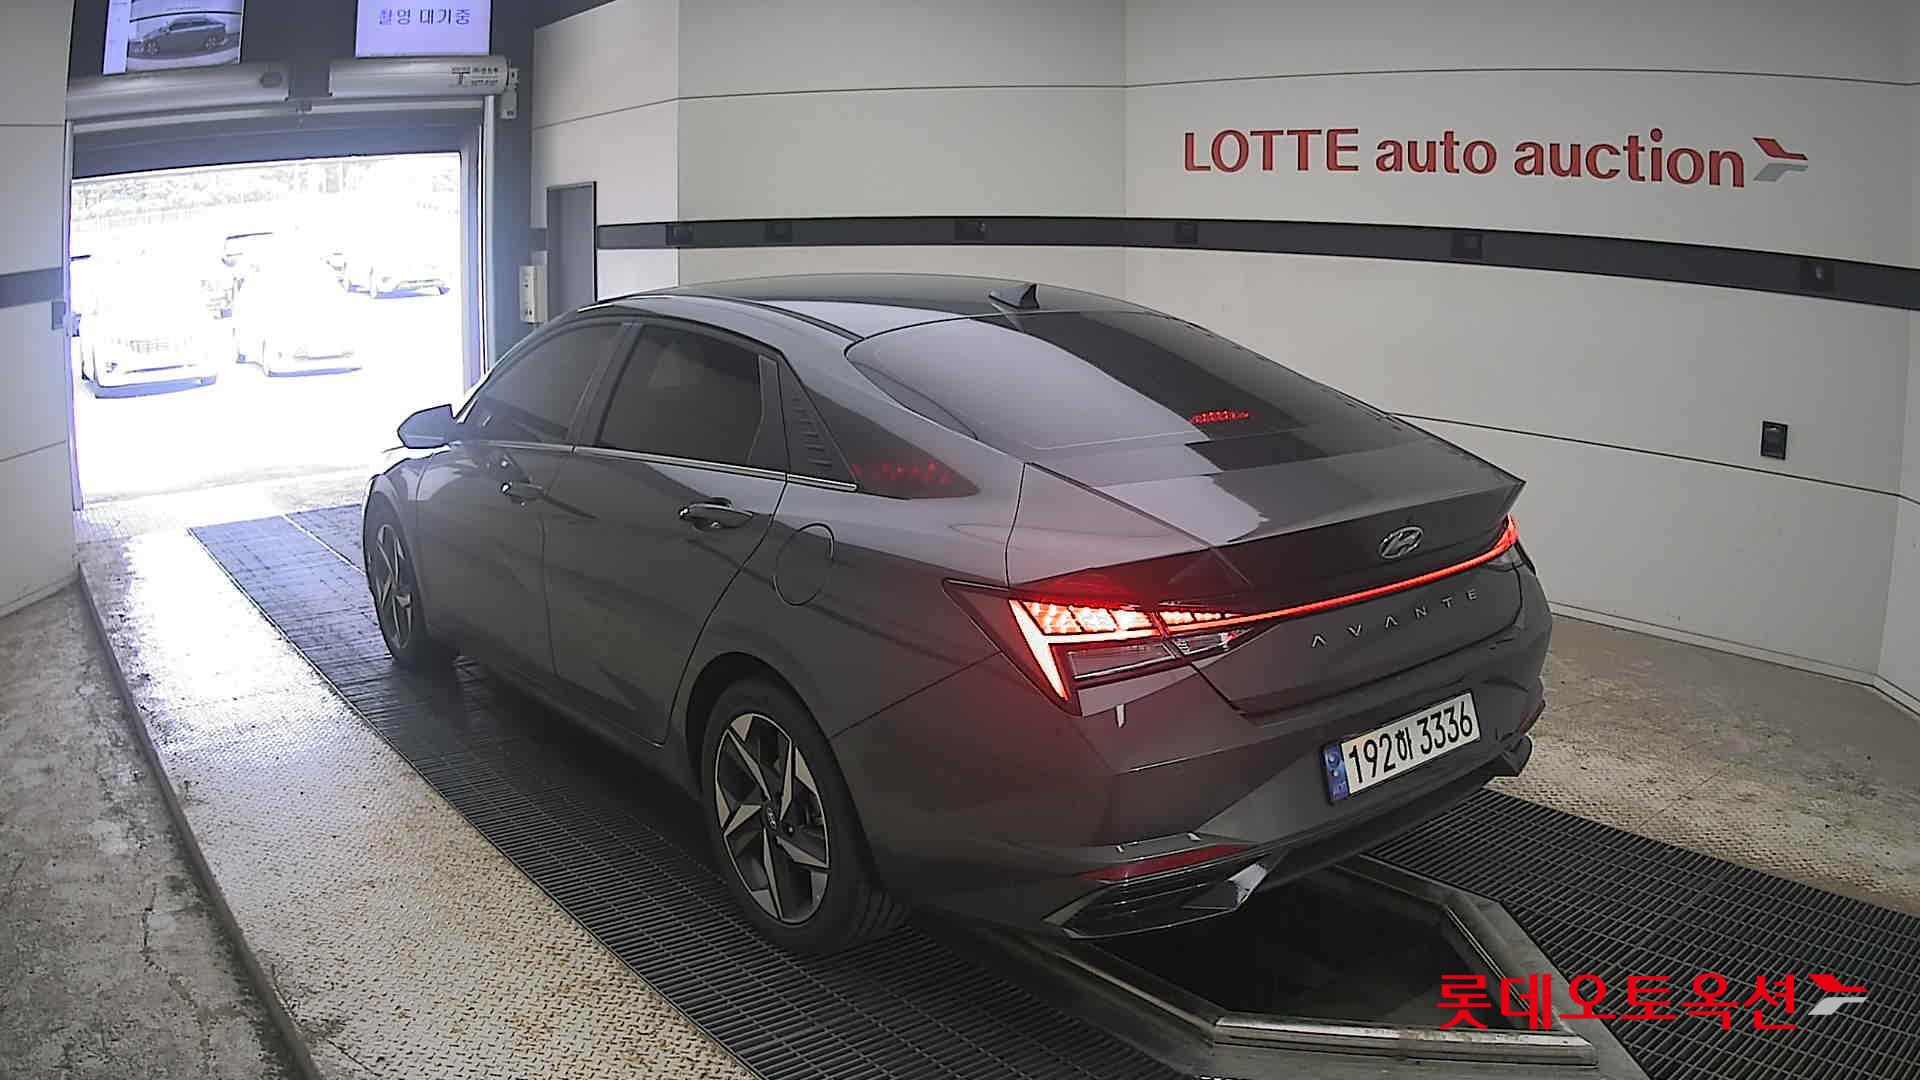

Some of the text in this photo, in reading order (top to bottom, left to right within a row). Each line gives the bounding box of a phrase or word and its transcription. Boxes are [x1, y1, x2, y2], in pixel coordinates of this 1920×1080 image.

[419, 8, 471, 25] 대기중
[1184, 127, 1745, 189] LOTTE auto auction
[1311, 589, 1478, 648] AVANTE
[1348, 701, 1474, 784] 192하 3336
